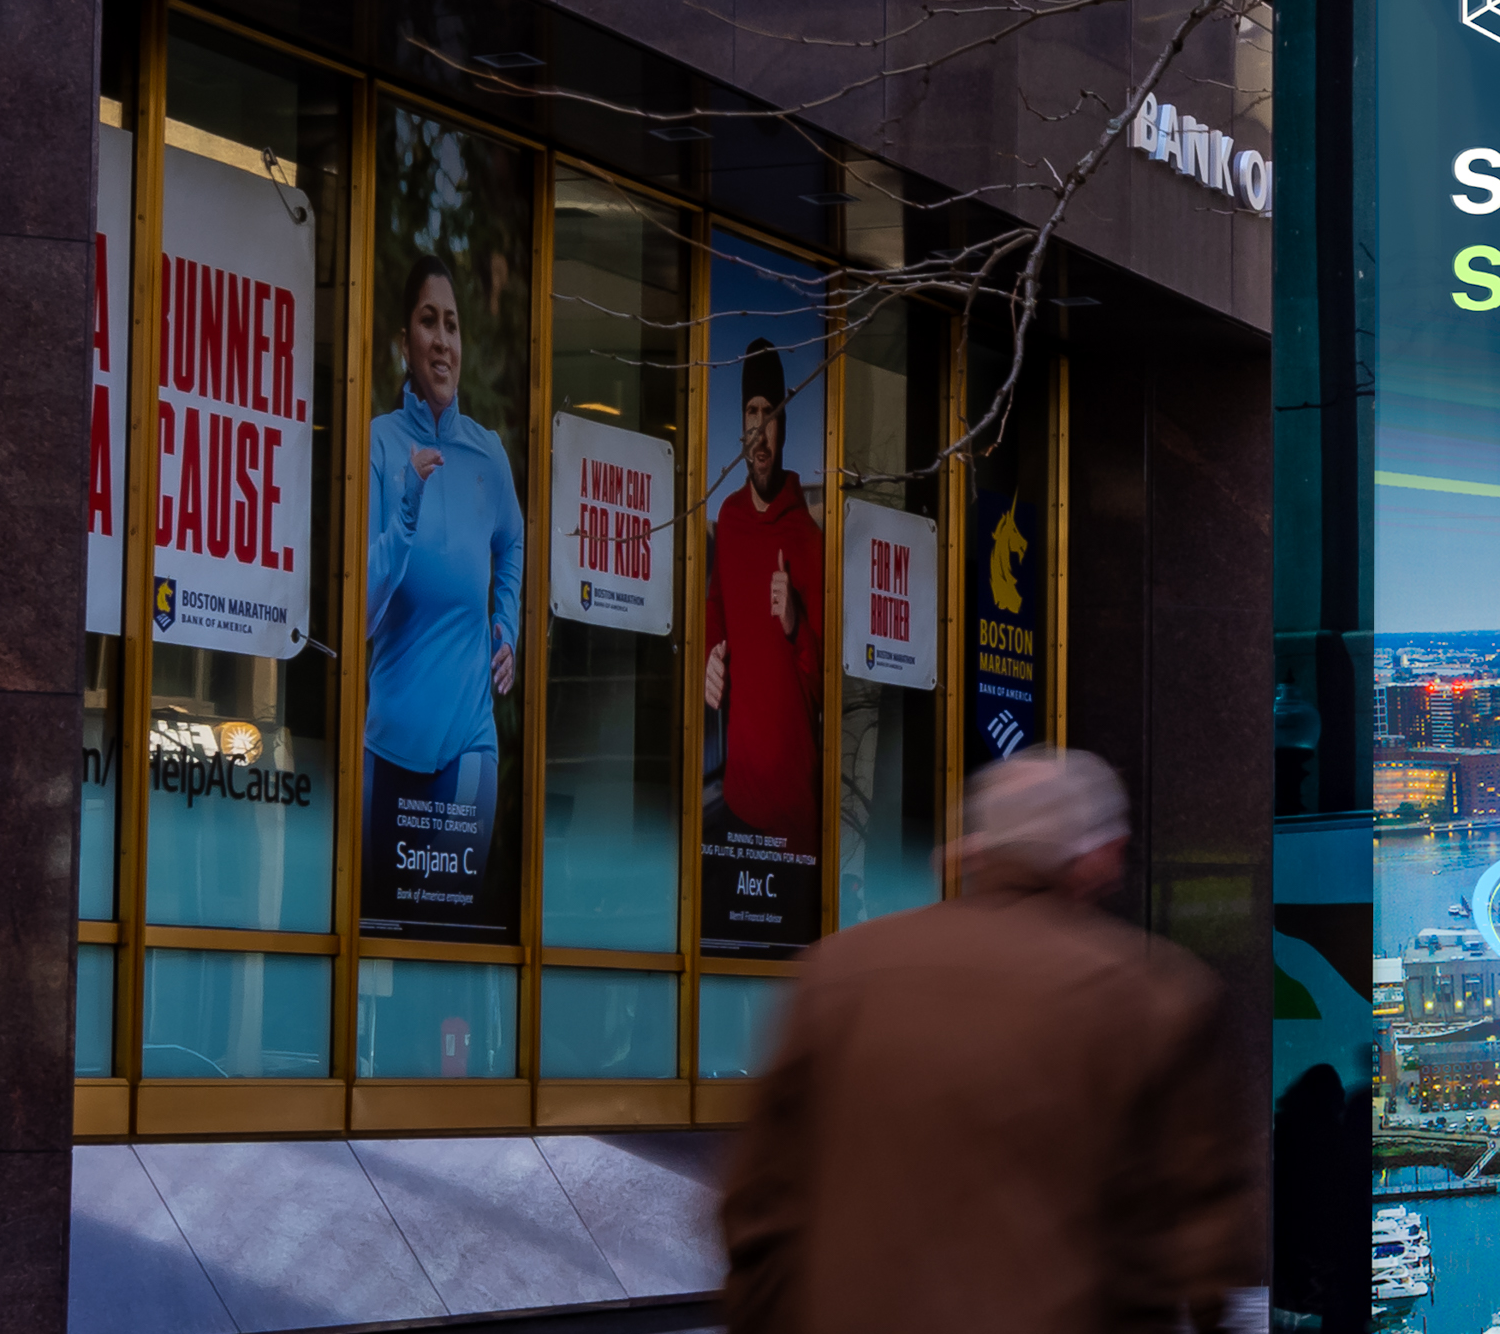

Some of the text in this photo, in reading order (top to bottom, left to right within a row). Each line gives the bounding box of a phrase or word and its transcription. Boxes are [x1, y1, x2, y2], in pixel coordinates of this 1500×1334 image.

[1128, 91, 1234, 197] BANK
[88, 384, 294, 573] A CAUSE.
[581, 457, 651, 513] A WARM COAT
[580, 503, 651, 581] FOR KIDS
[871, 538, 910, 597] FOR MY
[181, 614, 253, 634] BANK OF AMERICA
[182, 589, 288, 624] BOSTON MARATHON
[871, 593, 909, 642] BROTHER
[980, 619, 1033, 656] BOSTON
[980, 652, 1033, 681] MARATHON
[979, 683, 1033, 702] BANK OF AMERICA
[397, 814, 478, 834] CRADLES TO CRAYONS
[398, 797, 477, 816] RUNNING TO BENEFIT
[396, 840, 477, 878] Sanjana C.
[736, 870, 777, 898] Alex C.
